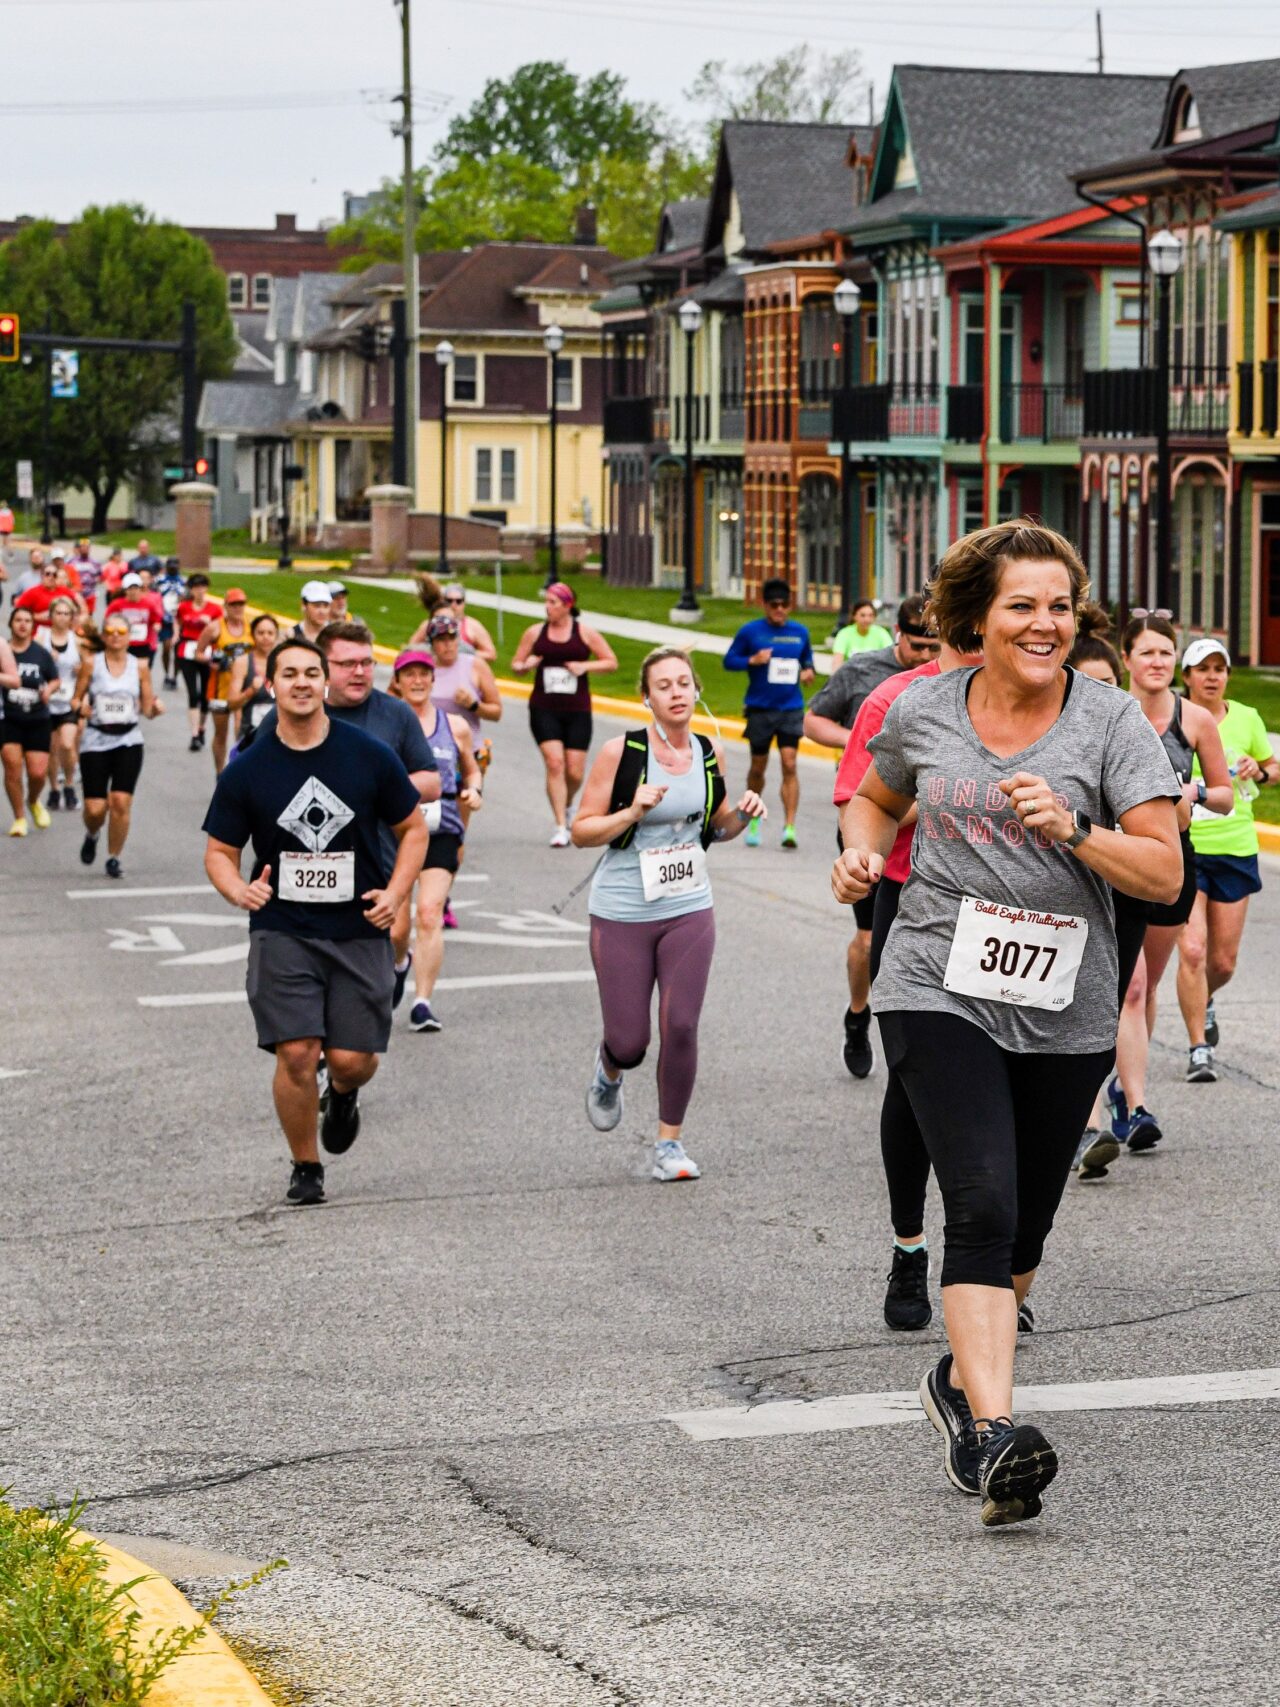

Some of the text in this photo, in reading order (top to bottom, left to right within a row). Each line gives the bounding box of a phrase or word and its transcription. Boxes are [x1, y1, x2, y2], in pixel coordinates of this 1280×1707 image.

[928, 776, 1069, 811] UND
[923, 812, 1069, 852] ARMOU
[295, 869, 337, 889] 3228
[659, 860, 694, 884] 3094
[975, 900, 1078, 931] Bald Eagle Multisports
[980, 936, 1058, 982] 3077
